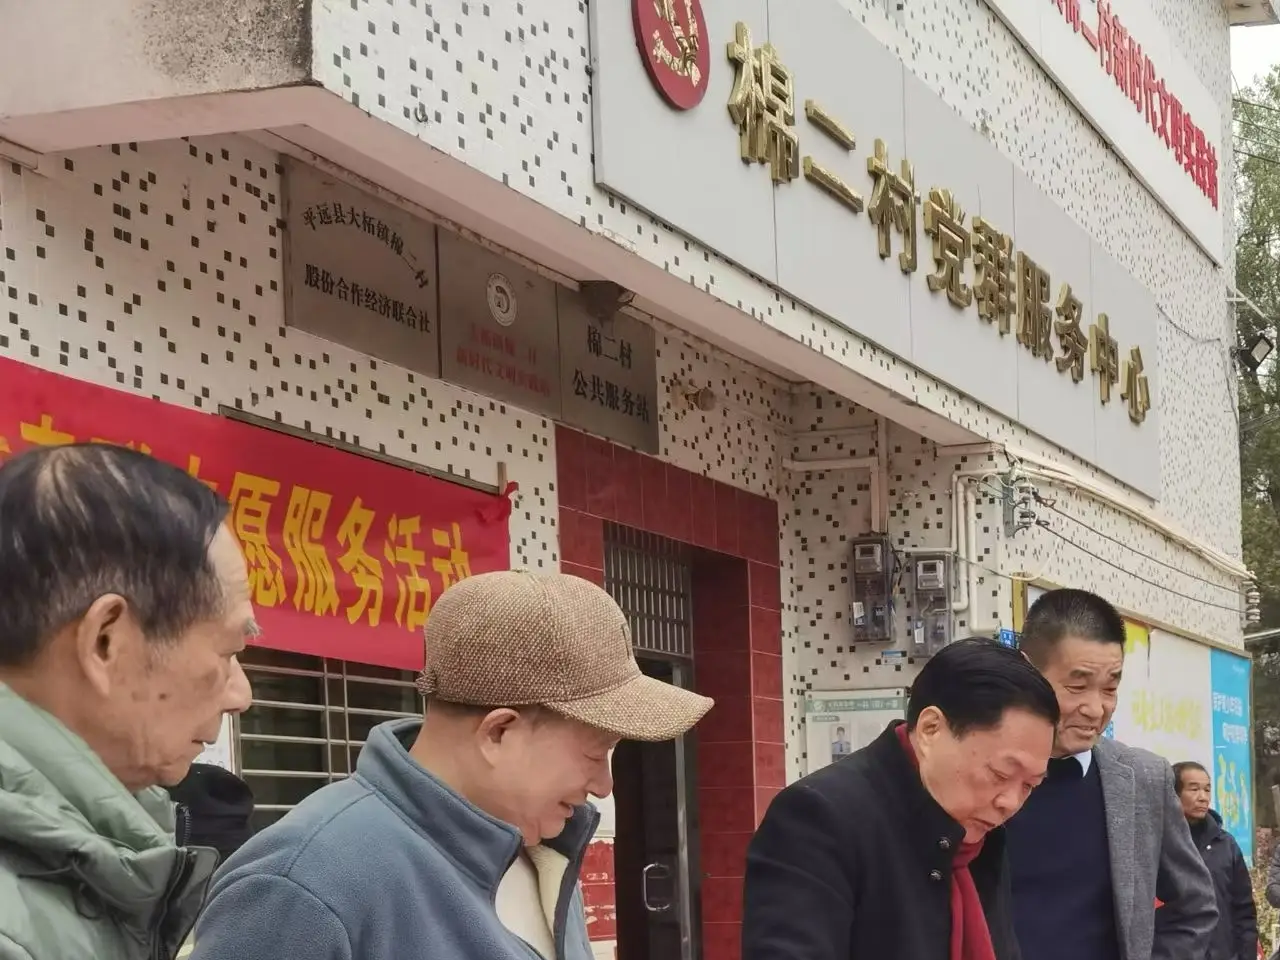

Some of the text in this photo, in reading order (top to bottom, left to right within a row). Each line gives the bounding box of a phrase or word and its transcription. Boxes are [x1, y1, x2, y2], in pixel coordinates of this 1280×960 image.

[1048, 0, 1219, 211] 二村新时代文明实践站
[302, 201, 429, 289] 平远县大柘镇棉二村
[727, 21, 1152, 425] 棉二村党群服务中心
[304, 263, 431, 334] 股份合作经济联合社
[586, 324, 633, 370] 棉二村
[572, 368, 650, 424] 公共服务站
